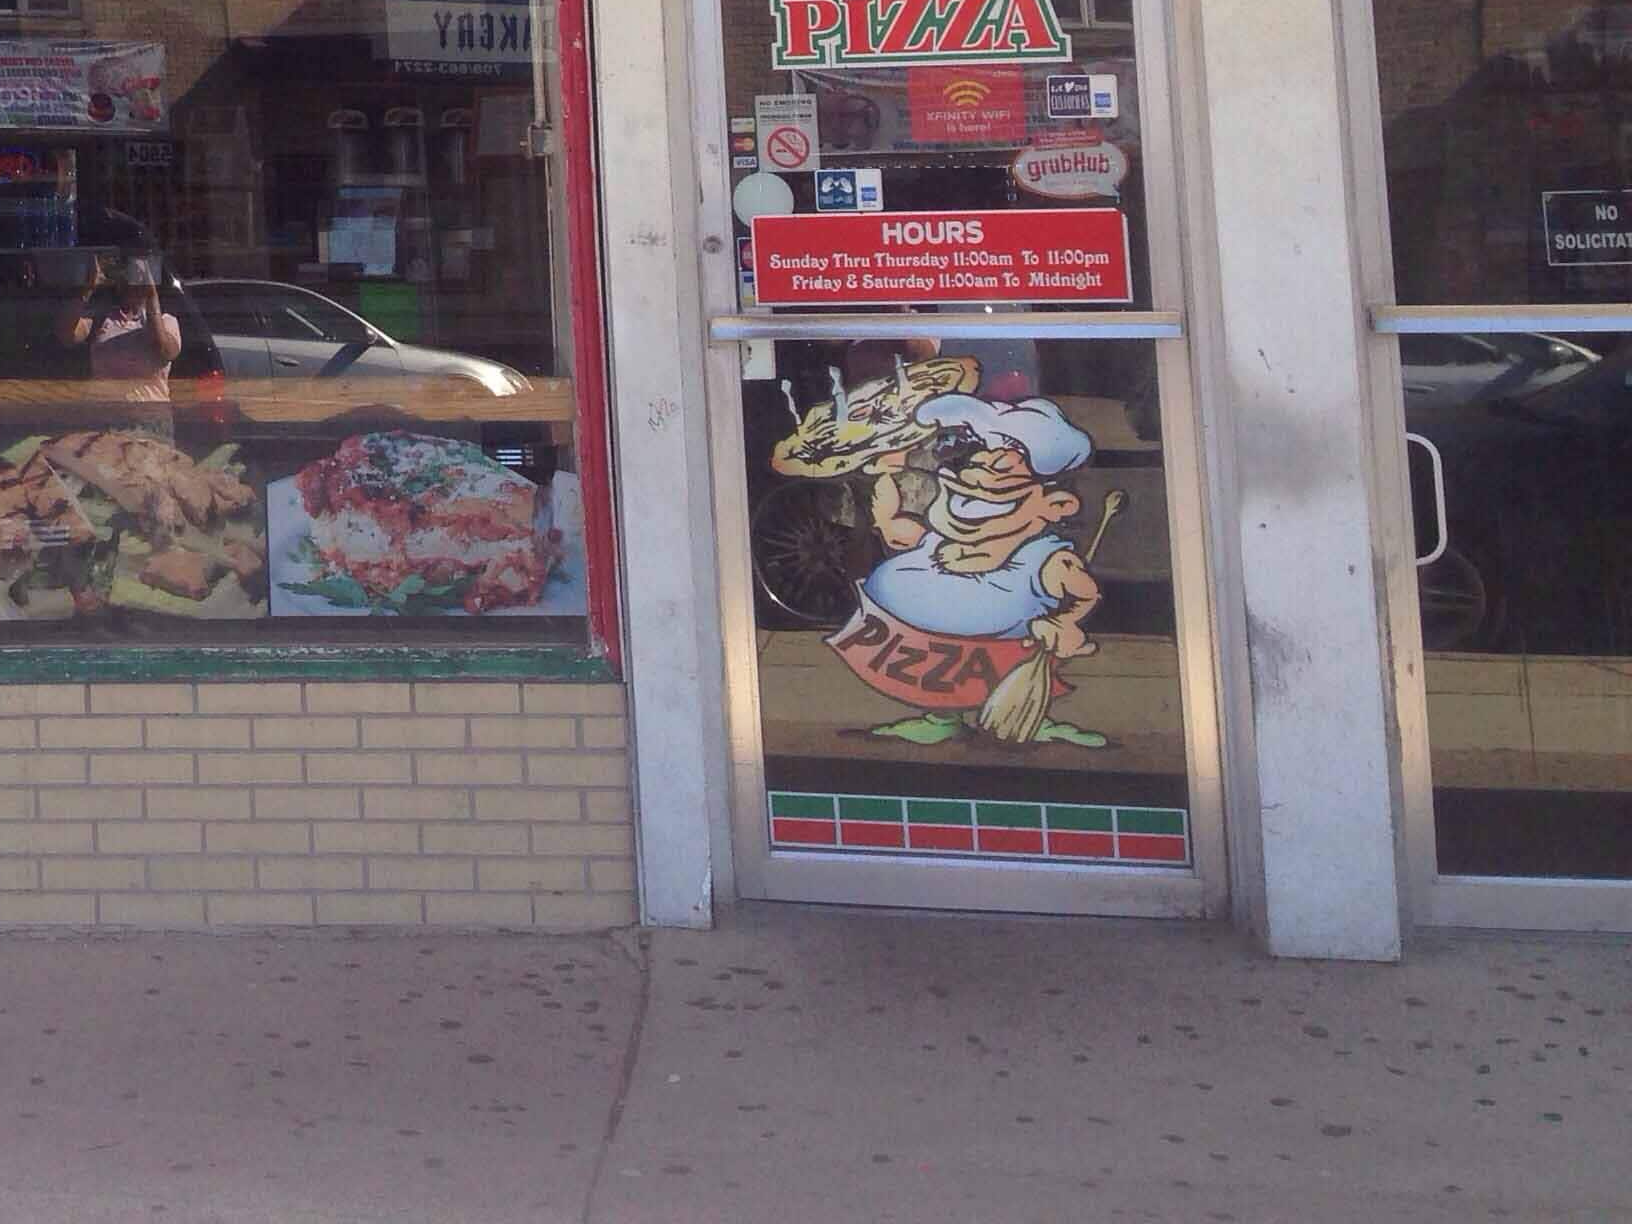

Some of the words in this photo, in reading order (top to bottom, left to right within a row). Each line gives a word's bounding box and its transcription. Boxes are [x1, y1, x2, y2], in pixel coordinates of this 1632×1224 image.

[926, 111, 977, 121] XFINITY
[736, 158, 756, 166] VISA
[1027, 152, 1110, 182] grubHub
[1594, 205, 1618, 221] NO
[881, 221, 985, 245] HOURS
[769, 253, 829, 270] Sunday
[832, 253, 870, 269] Thru
[873, 251, 950, 269] Thursday
[953, 251, 1013, 267] 11:00am
[1021, 250, 1040, 265] To
[1047, 249, 1110, 268] 11:00pm
[792, 274, 842, 292] Friday
[846, 275, 858, 289] &
[862, 274, 935, 291] Saturday
[939, 273, 998, 288] 11:00am
[1001, 272, 1020, 288] To
[1028, 271, 1103, 290] Midnight
[838, 614, 1001, 692] PIZZA
